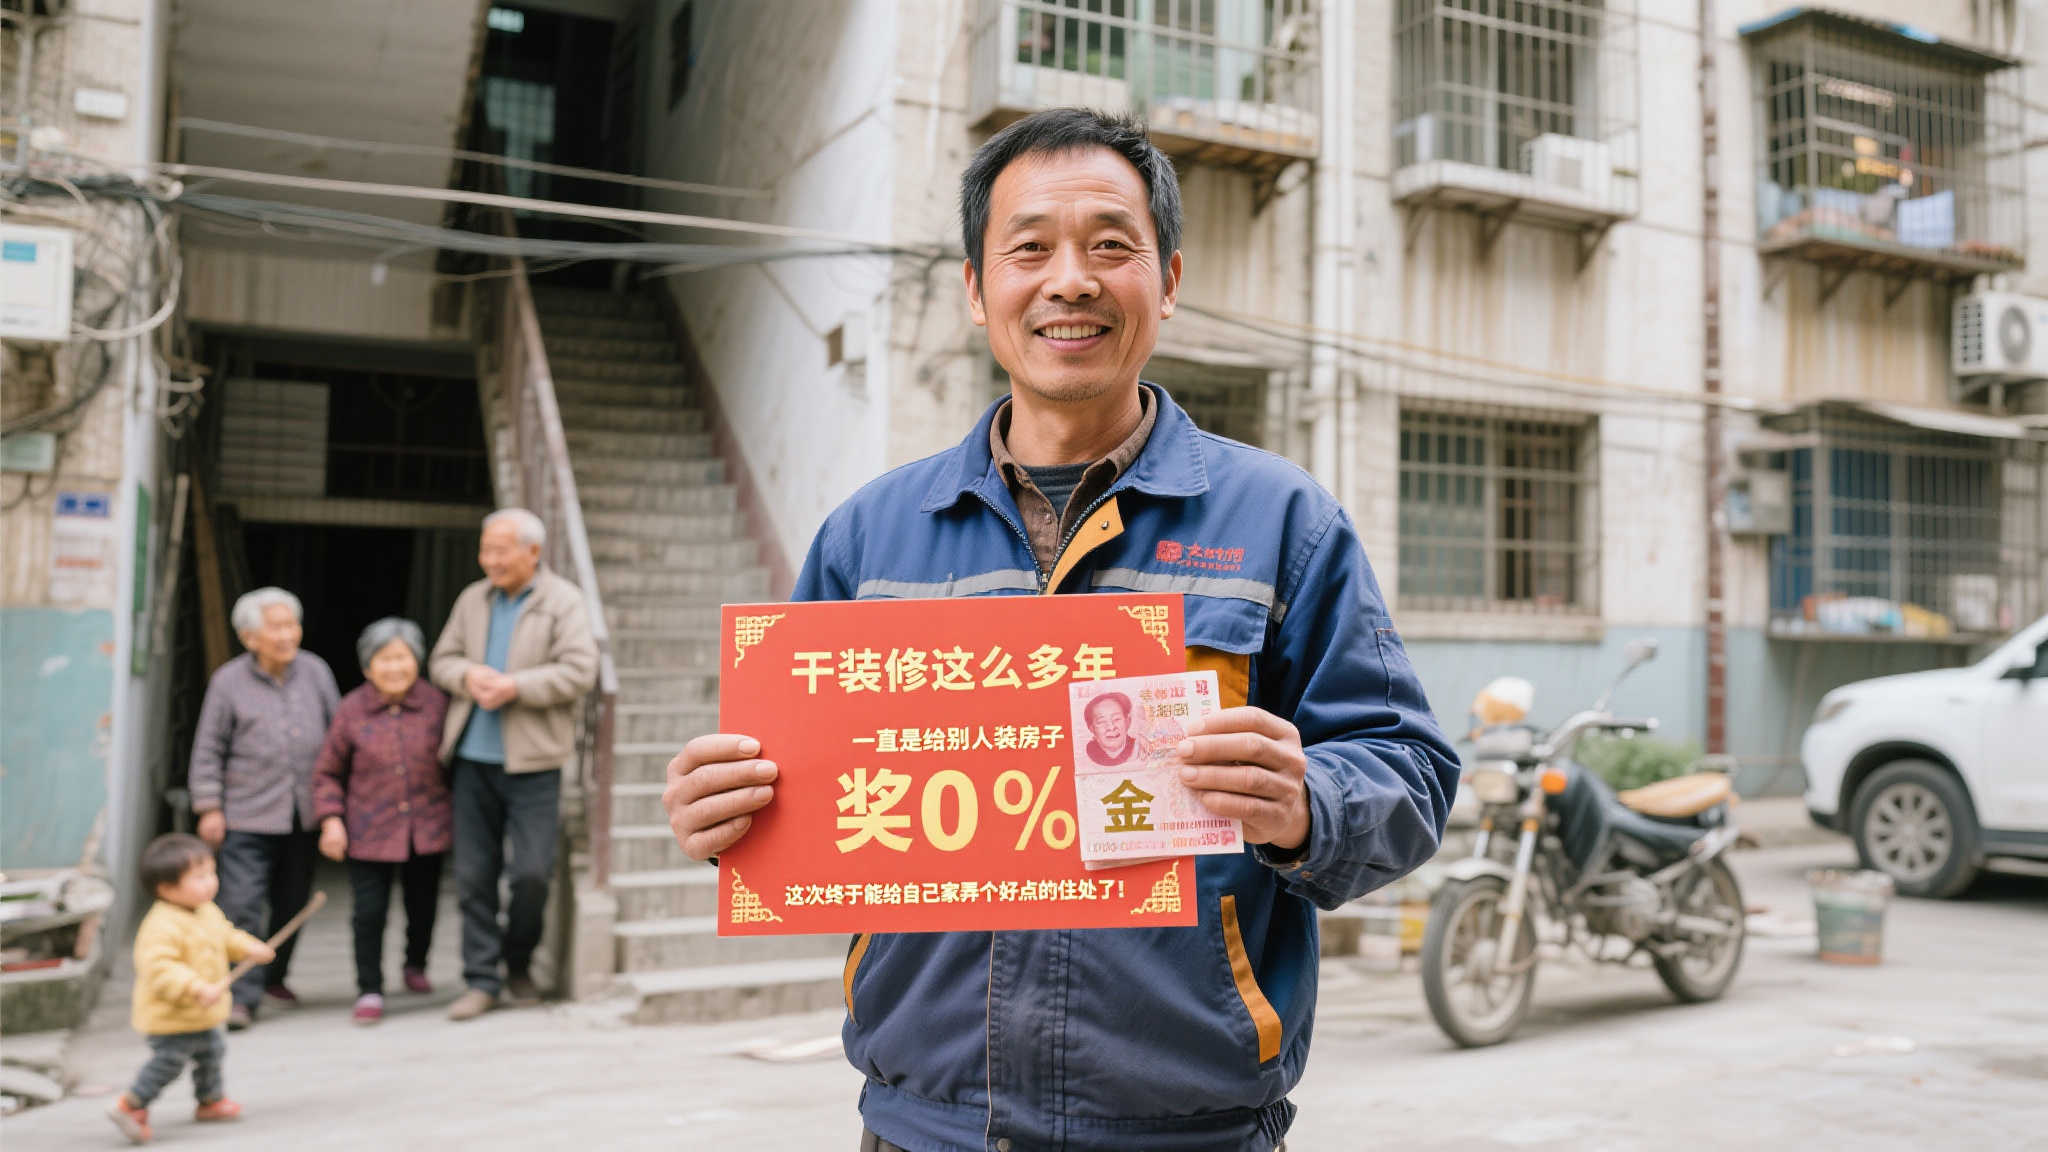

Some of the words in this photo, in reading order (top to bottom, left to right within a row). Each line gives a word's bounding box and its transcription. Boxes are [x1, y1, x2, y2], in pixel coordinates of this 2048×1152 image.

[791, 644, 1116, 694] 干装修这么多年
[853, 725, 1064, 752] 一直是给别人装房子
[1101, 779, 1154, 833] 金
